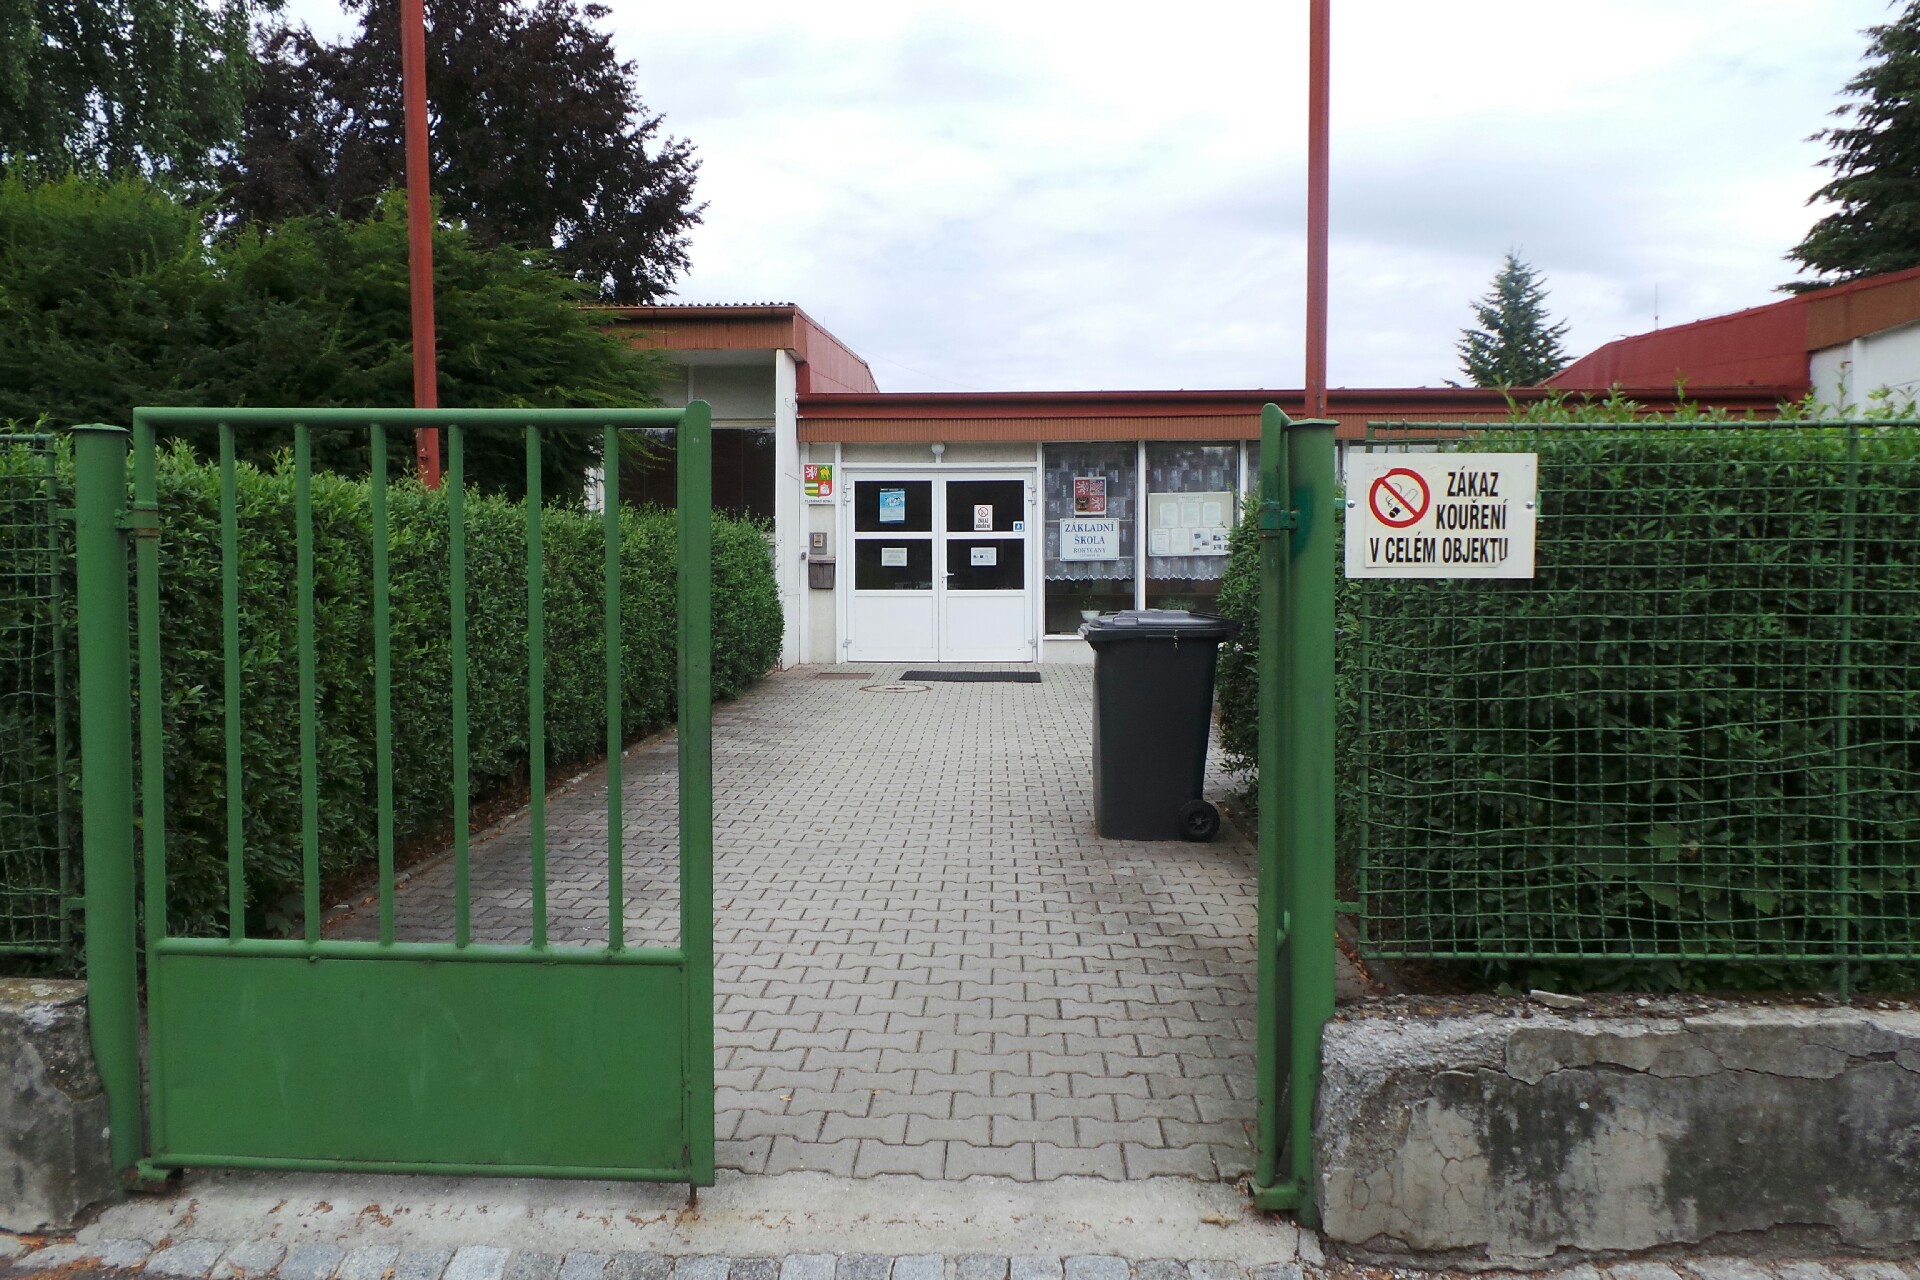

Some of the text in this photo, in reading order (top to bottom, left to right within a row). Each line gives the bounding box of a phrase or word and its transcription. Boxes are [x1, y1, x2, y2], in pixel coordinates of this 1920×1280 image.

[1447, 466, 1499, 497] ZÁKAZ
[1065, 521, 1114, 532] ZÁKLADNÍ
[1436, 499, 1508, 530] KOUŘENÍ
[1074, 534, 1105, 544] ŠKOLA
[1370, 531, 1508, 563] V CELÉM OBJEKTU
